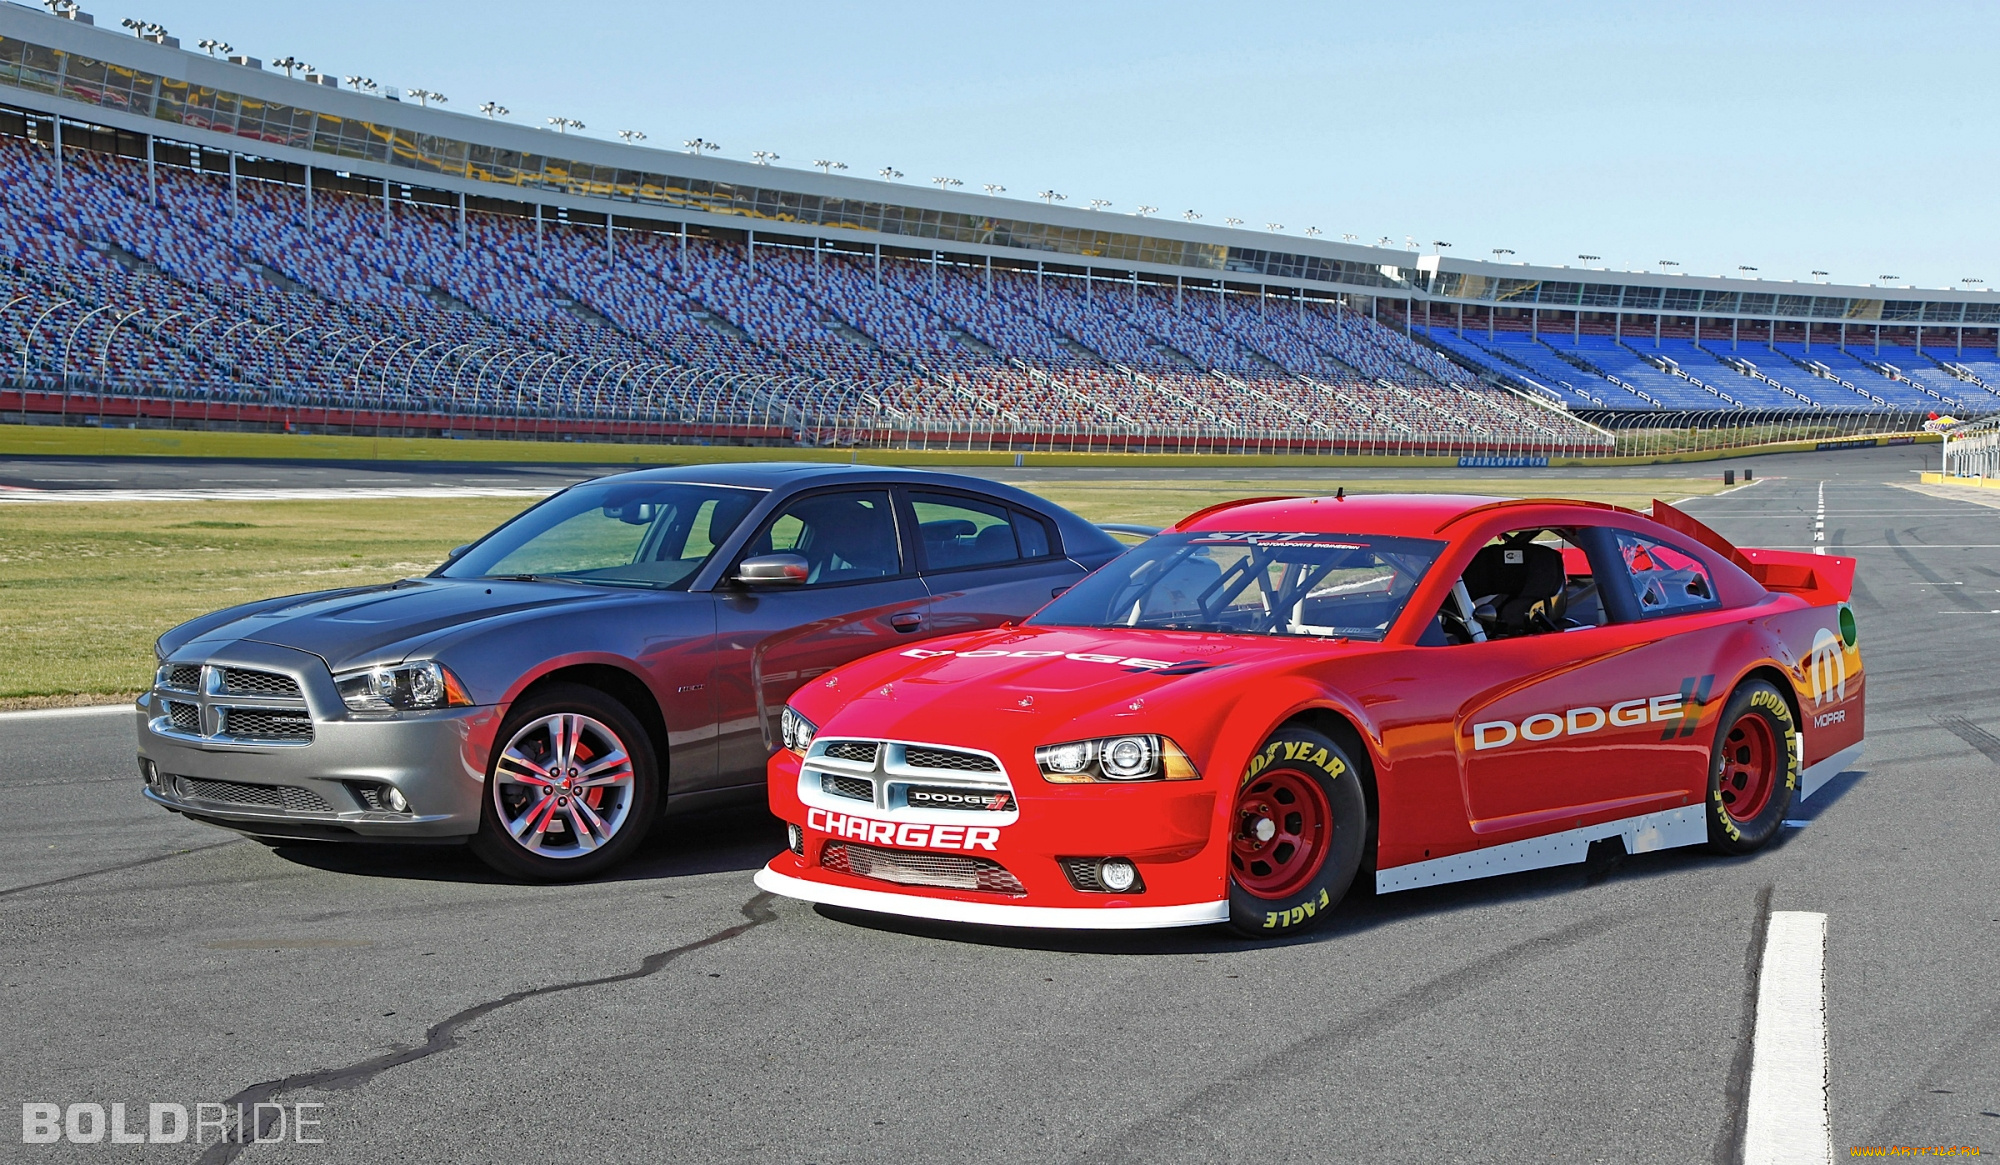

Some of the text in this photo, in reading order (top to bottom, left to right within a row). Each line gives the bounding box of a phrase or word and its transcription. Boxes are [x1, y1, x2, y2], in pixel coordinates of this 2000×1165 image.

[1459, 457, 1548, 467] CHARLOTTE USA
[1193, 532, 1319, 544] SRT
[899, 648, 1181, 670] DODGE
[1473, 693, 1684, 750] DODGE
[1814, 709, 1846, 728] MOPAR
[915, 792, 997, 805] DODGE
[1713, 789, 1741, 842] EAGLE
[807, 807, 1001, 851] CHARGER
[1262, 887, 1330, 928] EAGLE
